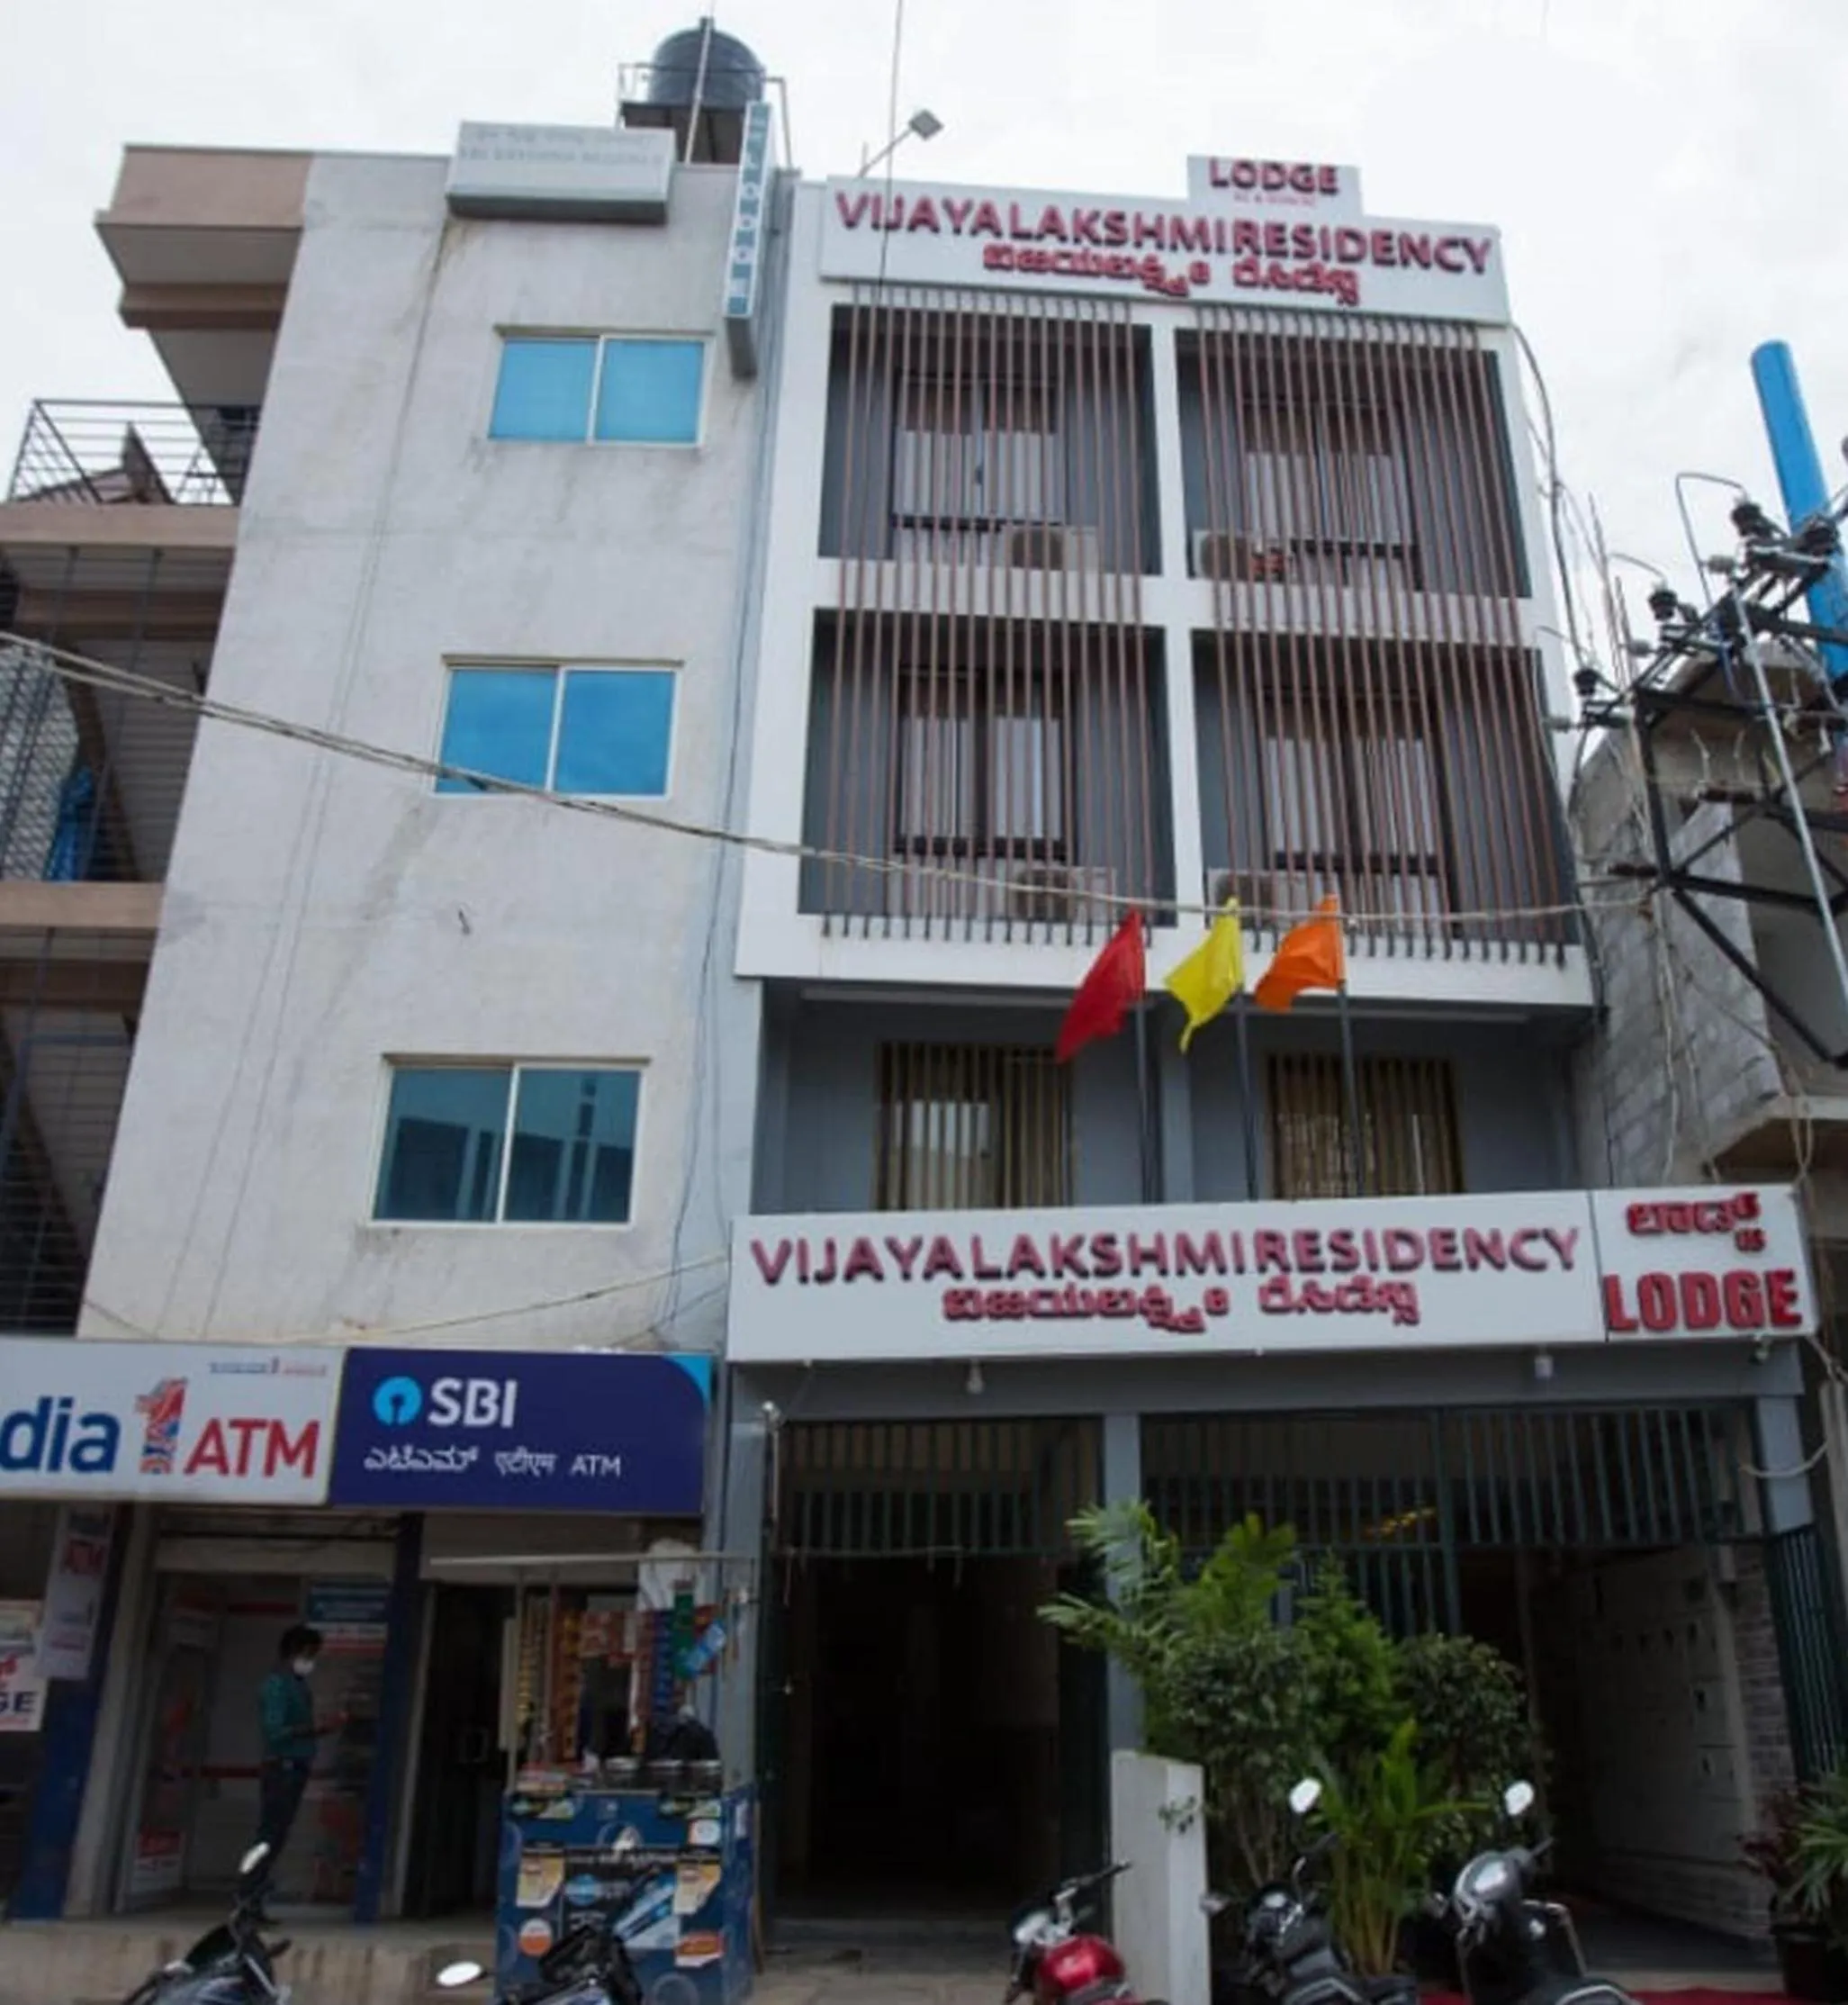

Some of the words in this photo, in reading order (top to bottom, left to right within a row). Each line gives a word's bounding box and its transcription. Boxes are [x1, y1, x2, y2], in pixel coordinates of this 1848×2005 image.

[1209, 157, 1339, 196] LODGE
[1601, 1268, 1804, 1332] LODGE
[428, 1377, 518, 1429] SBI
[183, 1416, 321, 1479] ATM
[569, 1452, 622, 1477] ATM
